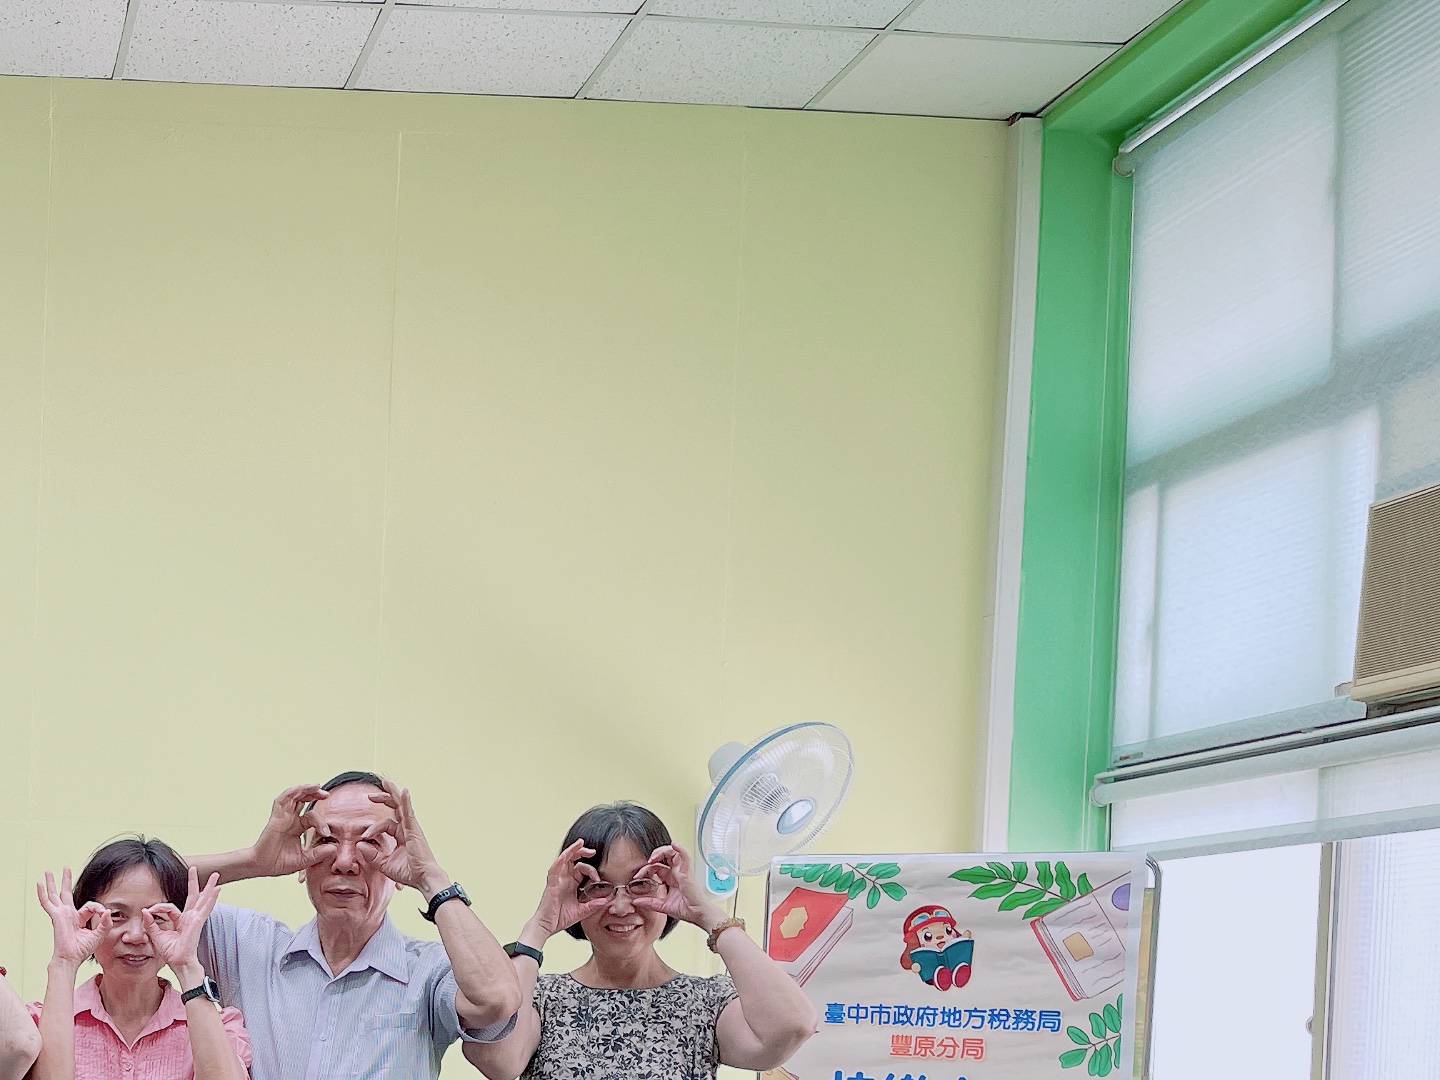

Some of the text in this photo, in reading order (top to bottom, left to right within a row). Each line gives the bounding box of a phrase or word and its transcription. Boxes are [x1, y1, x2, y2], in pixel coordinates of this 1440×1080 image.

[823, 1002, 1062, 1033] 臺中市政府地方稅務局
[889, 1034, 985, 1061] 豐原分局
